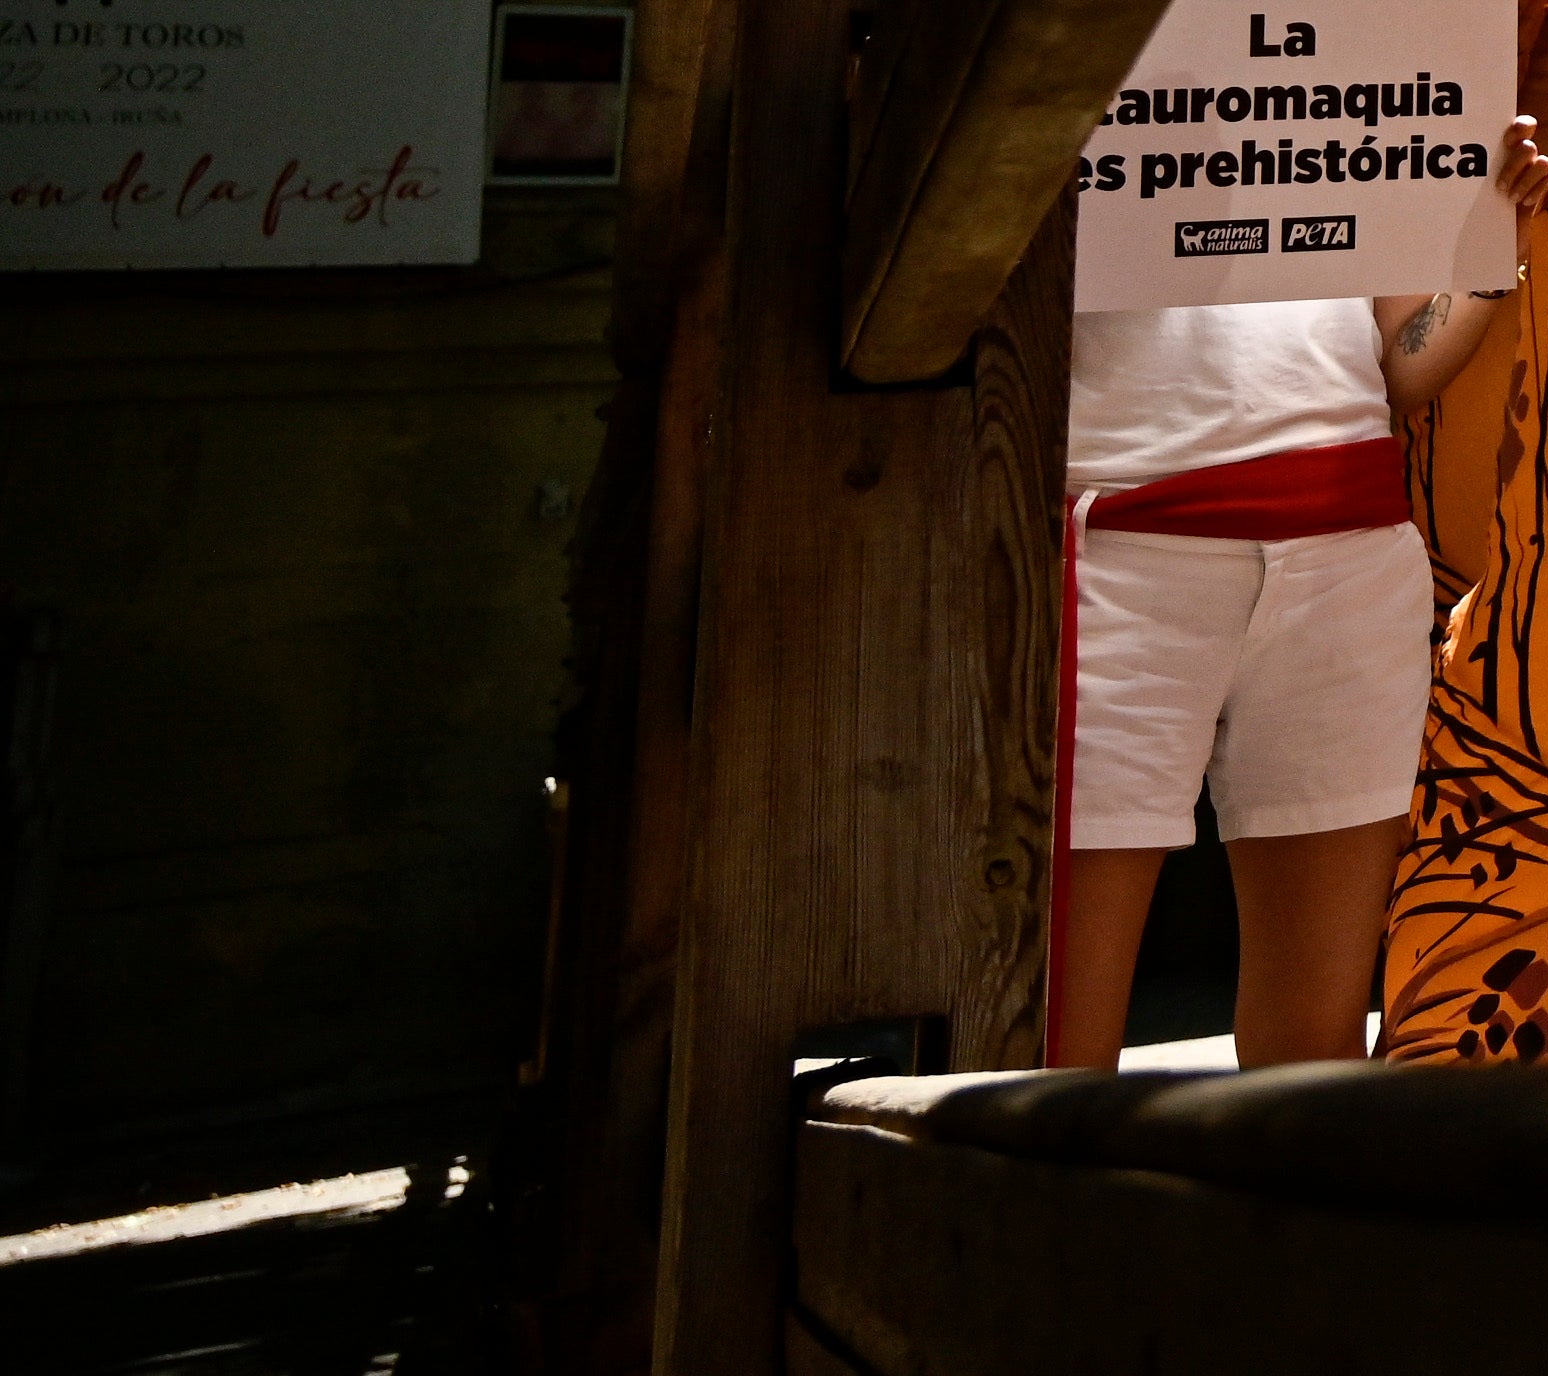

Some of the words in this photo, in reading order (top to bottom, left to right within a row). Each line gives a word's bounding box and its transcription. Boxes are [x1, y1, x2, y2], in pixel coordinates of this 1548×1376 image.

[53, 21, 105, 47] DE
[115, 23, 245, 49] TOROS
[1249, 13, 1316, 57] La
[100, 62, 207, 93] 2022
[1098, 72, 1463, 126] auromaquia
[1140, 135, 1488, 198] prehistórica
[102, 151, 166, 230] de
[177, 154, 256, 218] la
[262, 146, 441, 238] fiesta
[1207, 224, 1262, 241] anima
[1207, 237, 1263, 252] naturalis
